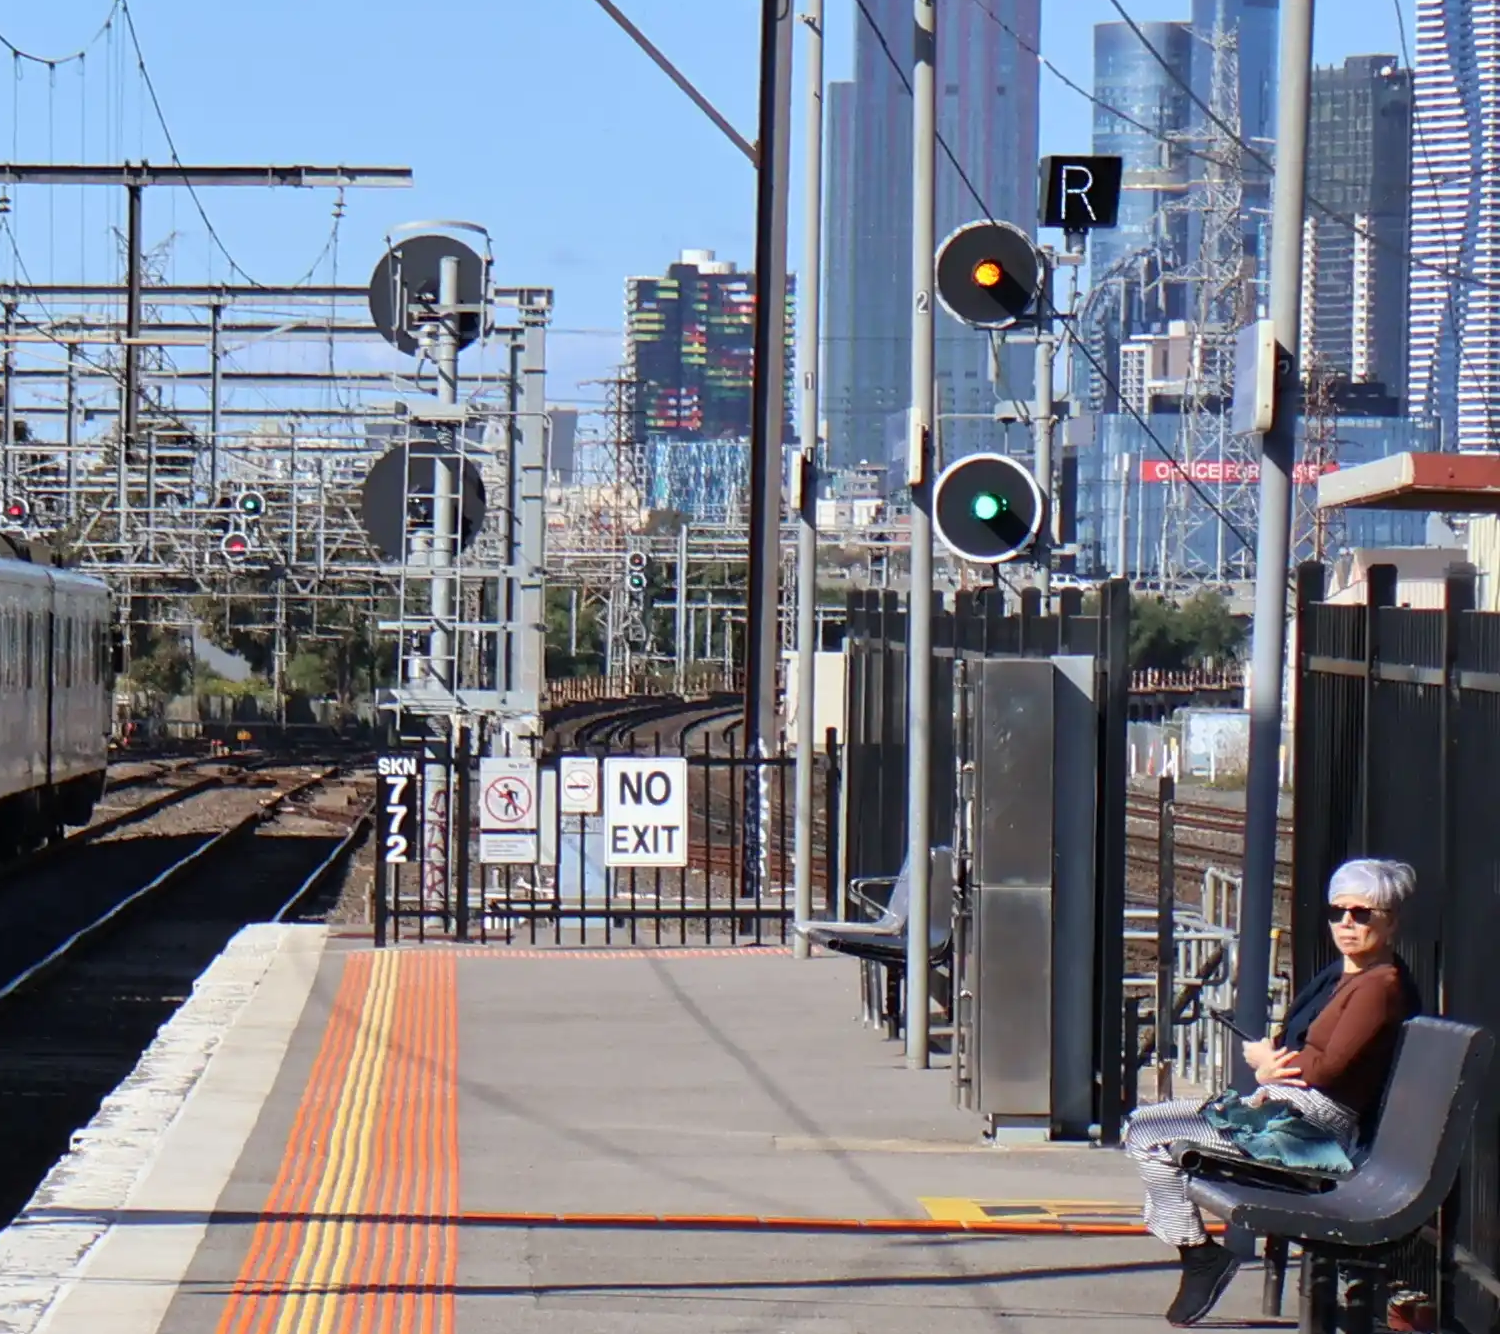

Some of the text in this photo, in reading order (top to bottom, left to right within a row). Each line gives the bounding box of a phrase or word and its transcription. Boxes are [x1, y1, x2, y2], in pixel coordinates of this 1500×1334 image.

[1061, 165, 1097, 221] R
[916, 291, 929, 314] 2
[378, 758, 417, 775] SKN
[619, 770, 672, 806] NO
[386, 777, 408, 863] 772
[612, 825, 680, 854] EXIT
